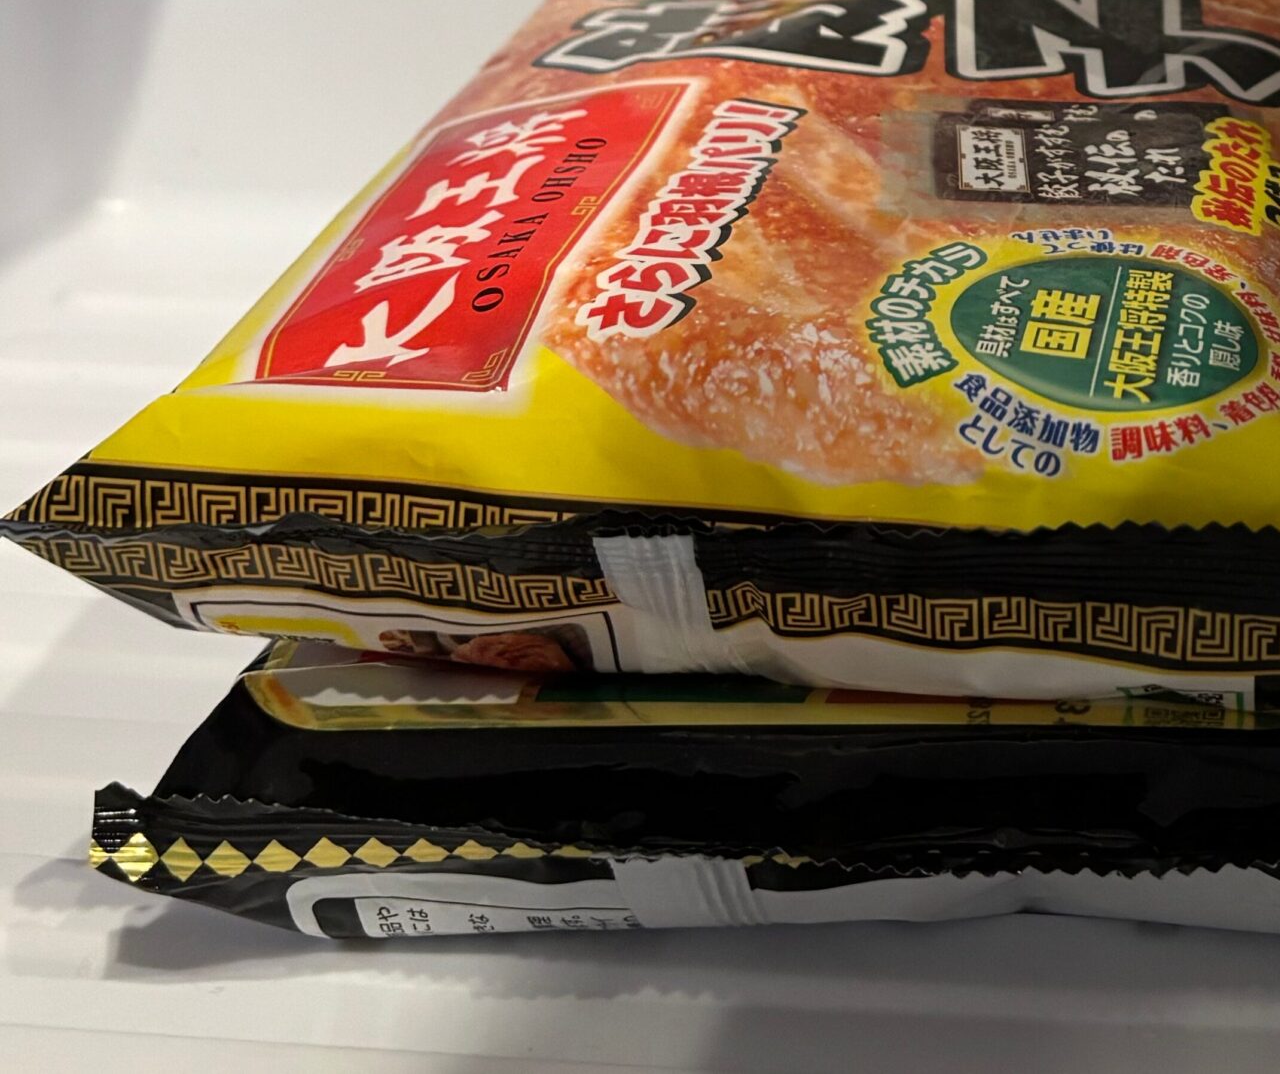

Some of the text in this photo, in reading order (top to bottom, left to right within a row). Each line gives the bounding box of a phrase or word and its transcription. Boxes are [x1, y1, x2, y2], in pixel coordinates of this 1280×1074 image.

[972, 129, 1004, 189] 大阪王将
[1034, 124, 1083, 199] 餃子がすすむ
[1084, 129, 1143, 196] 秘伝の
[1144, 147, 1187, 183] たれ
[1201, 120, 1266, 230] 秘伝のたれ
[325, 109, 588, 367] 大阪王将
[472, 137, 607, 313] OSAKA OHSHO
[872, 244, 982, 382] 素材のチカラ
[976, 276, 1030, 358] 具材はすべて
[1020, 288, 1102, 360] 国産
[1103, 269, 1174, 403] 大阪王将特製
[1167, 293, 1211, 387] 香りとコクの
[1208, 320, 1244, 371] 隠し味
[953, 373, 1100, 454] 食品添加物
[959, 414, 1062, 476] としての
